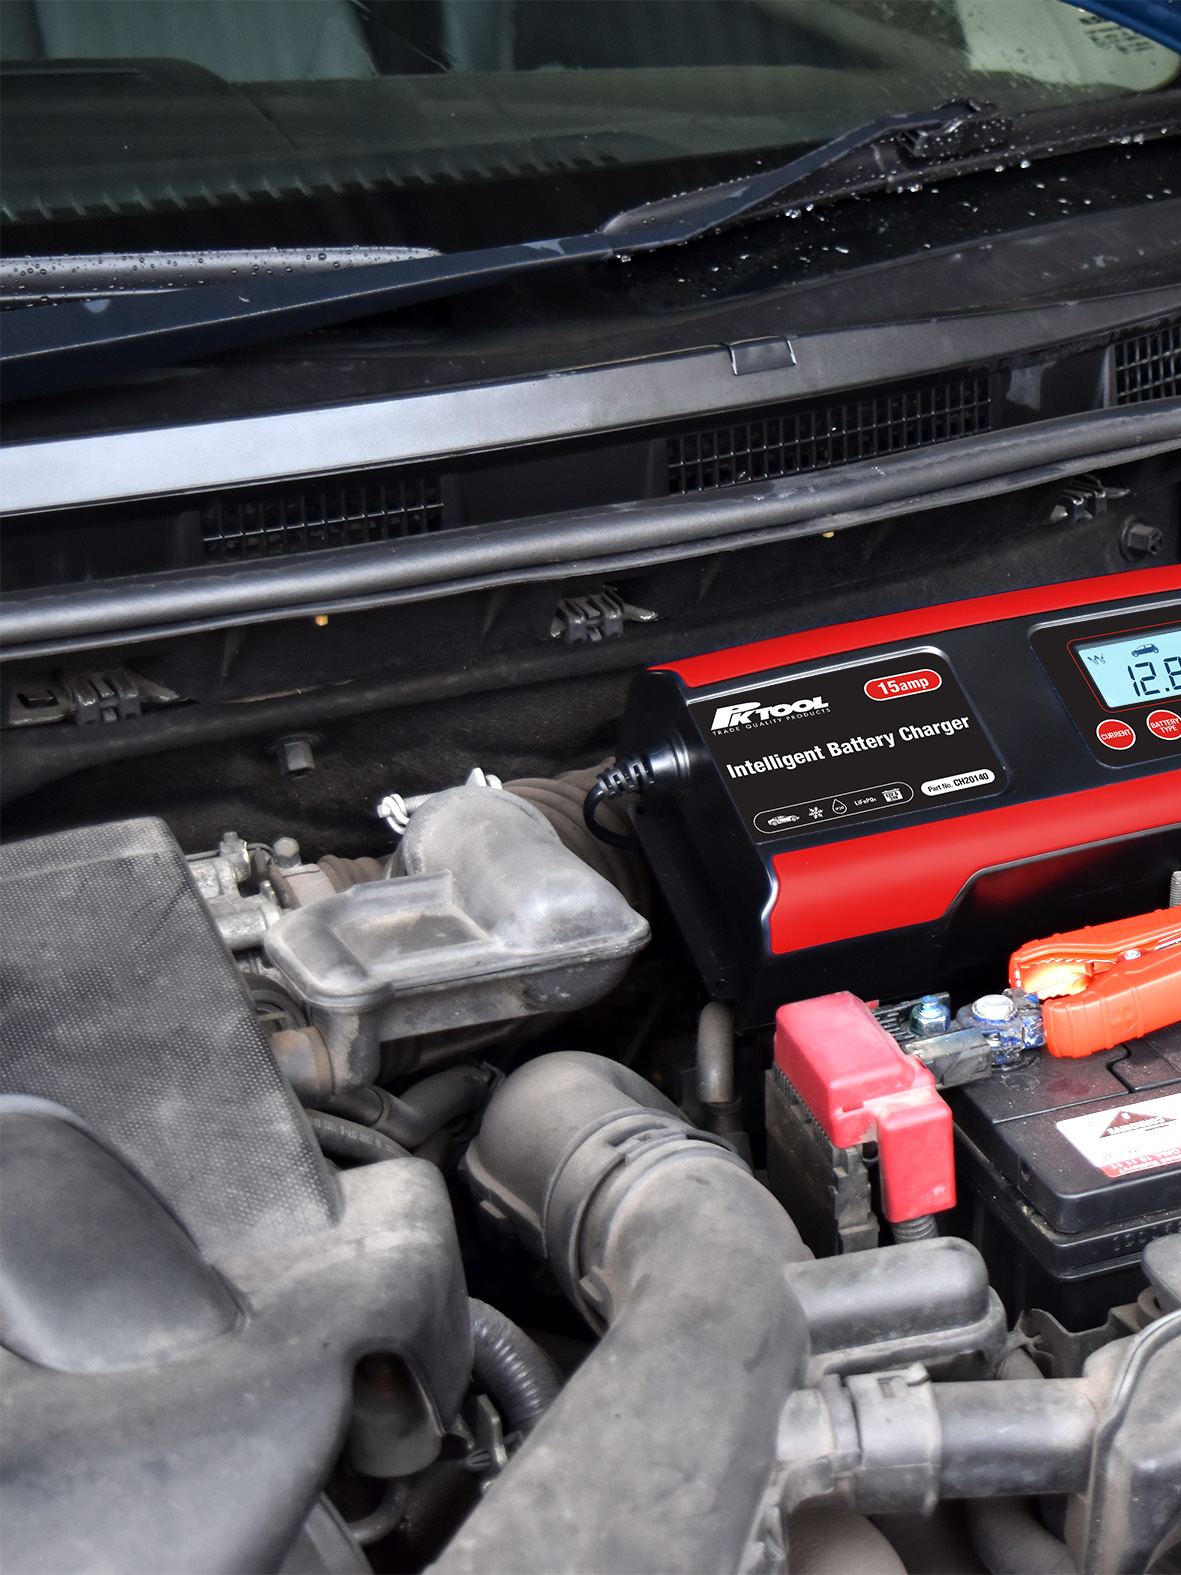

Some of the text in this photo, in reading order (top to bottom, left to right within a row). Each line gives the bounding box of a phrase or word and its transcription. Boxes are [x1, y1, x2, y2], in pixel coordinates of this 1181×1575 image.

[877, 675, 930, 695] 15amp
[712, 707, 831, 737] TRADE QUALITY PRODUCTS
[1150, 717, 1181, 730] BATTERY
[1159, 724, 1178, 734] TYPE
[1100, 728, 1132, 741] CURRENT
[725, 715, 971, 779] Intelligent Battery Charger
[927, 783, 942, 793] Part
[953, 772, 989, 787] CH20140
